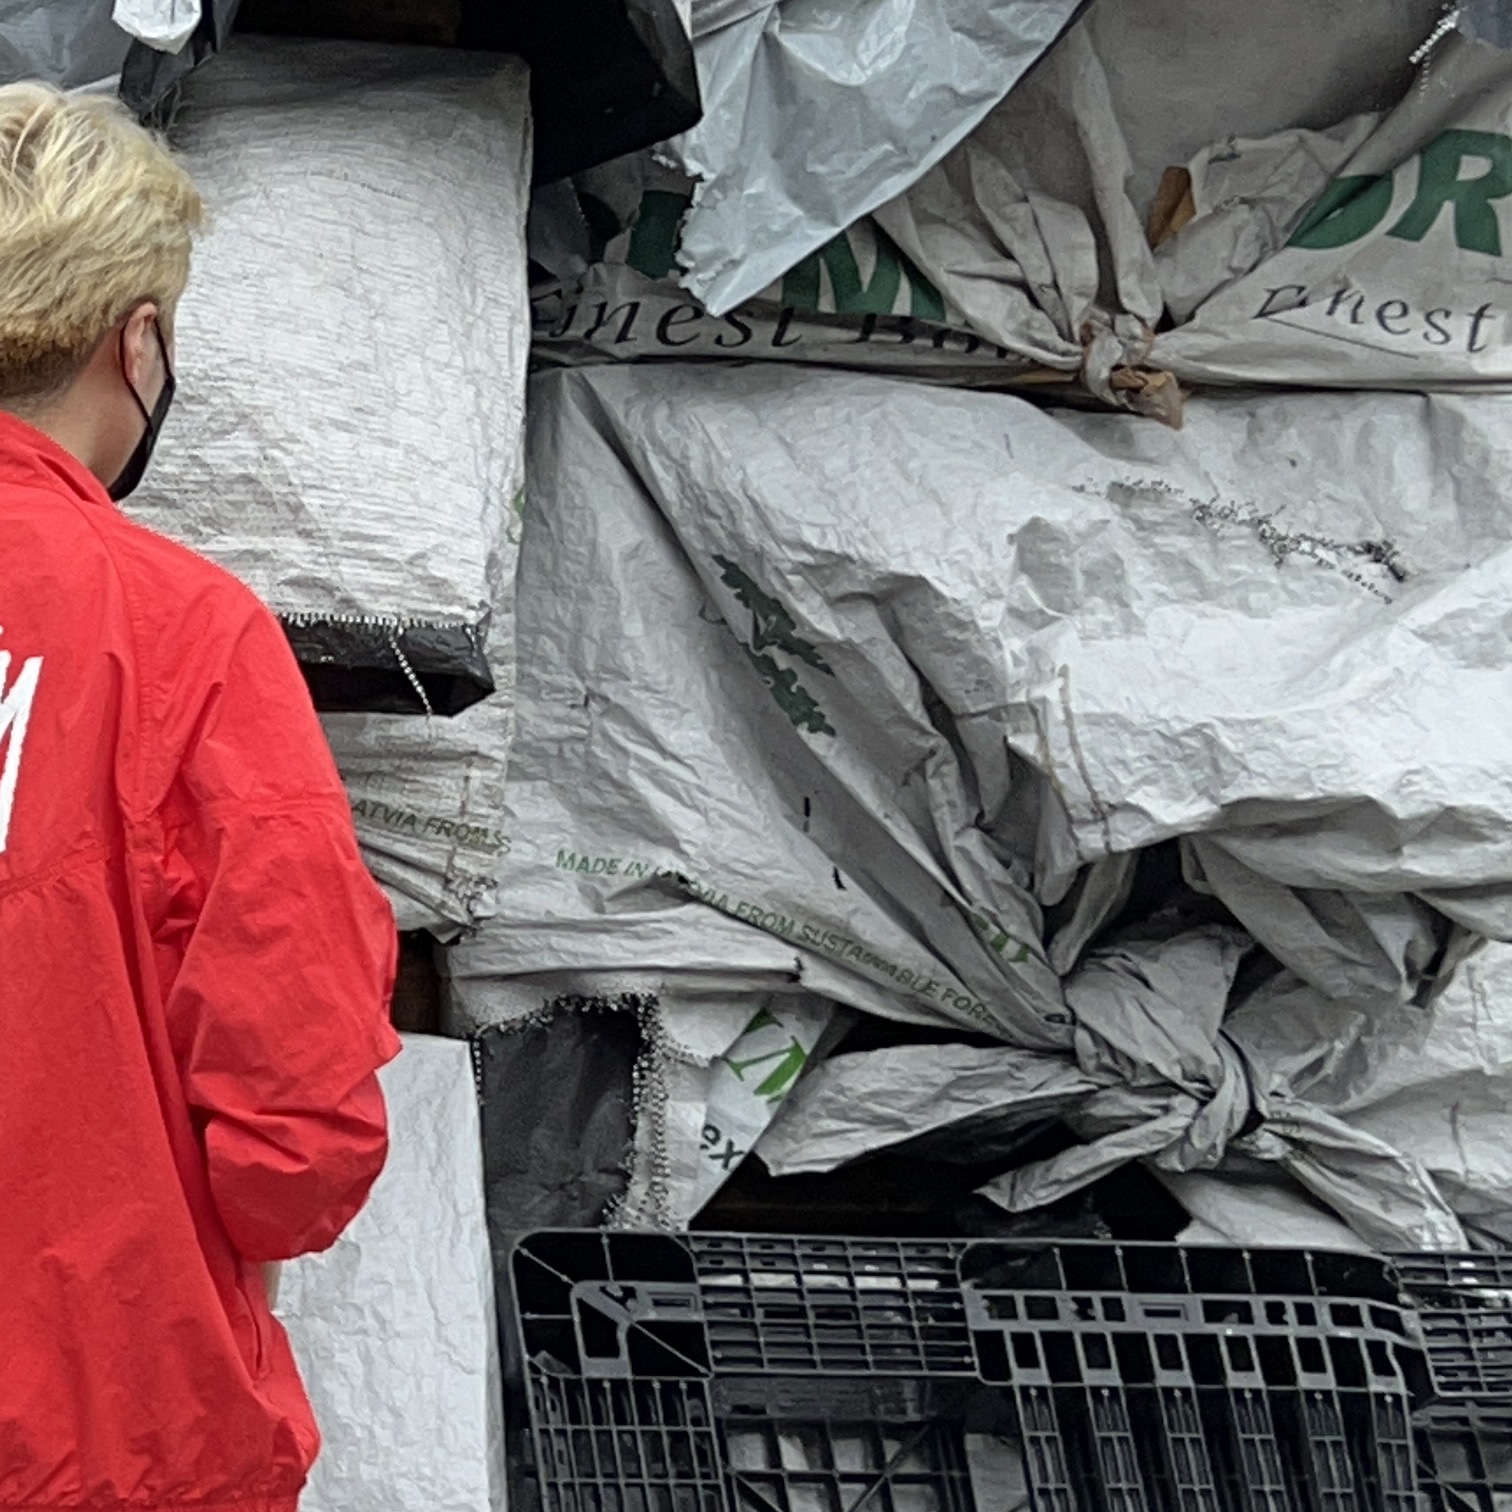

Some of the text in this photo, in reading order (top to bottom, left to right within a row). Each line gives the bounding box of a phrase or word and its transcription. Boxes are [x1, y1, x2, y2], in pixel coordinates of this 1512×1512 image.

[555, 848, 623, 877] MADE
[623, 860, 650, 879] IN
[735, 900, 795, 938] FROM
